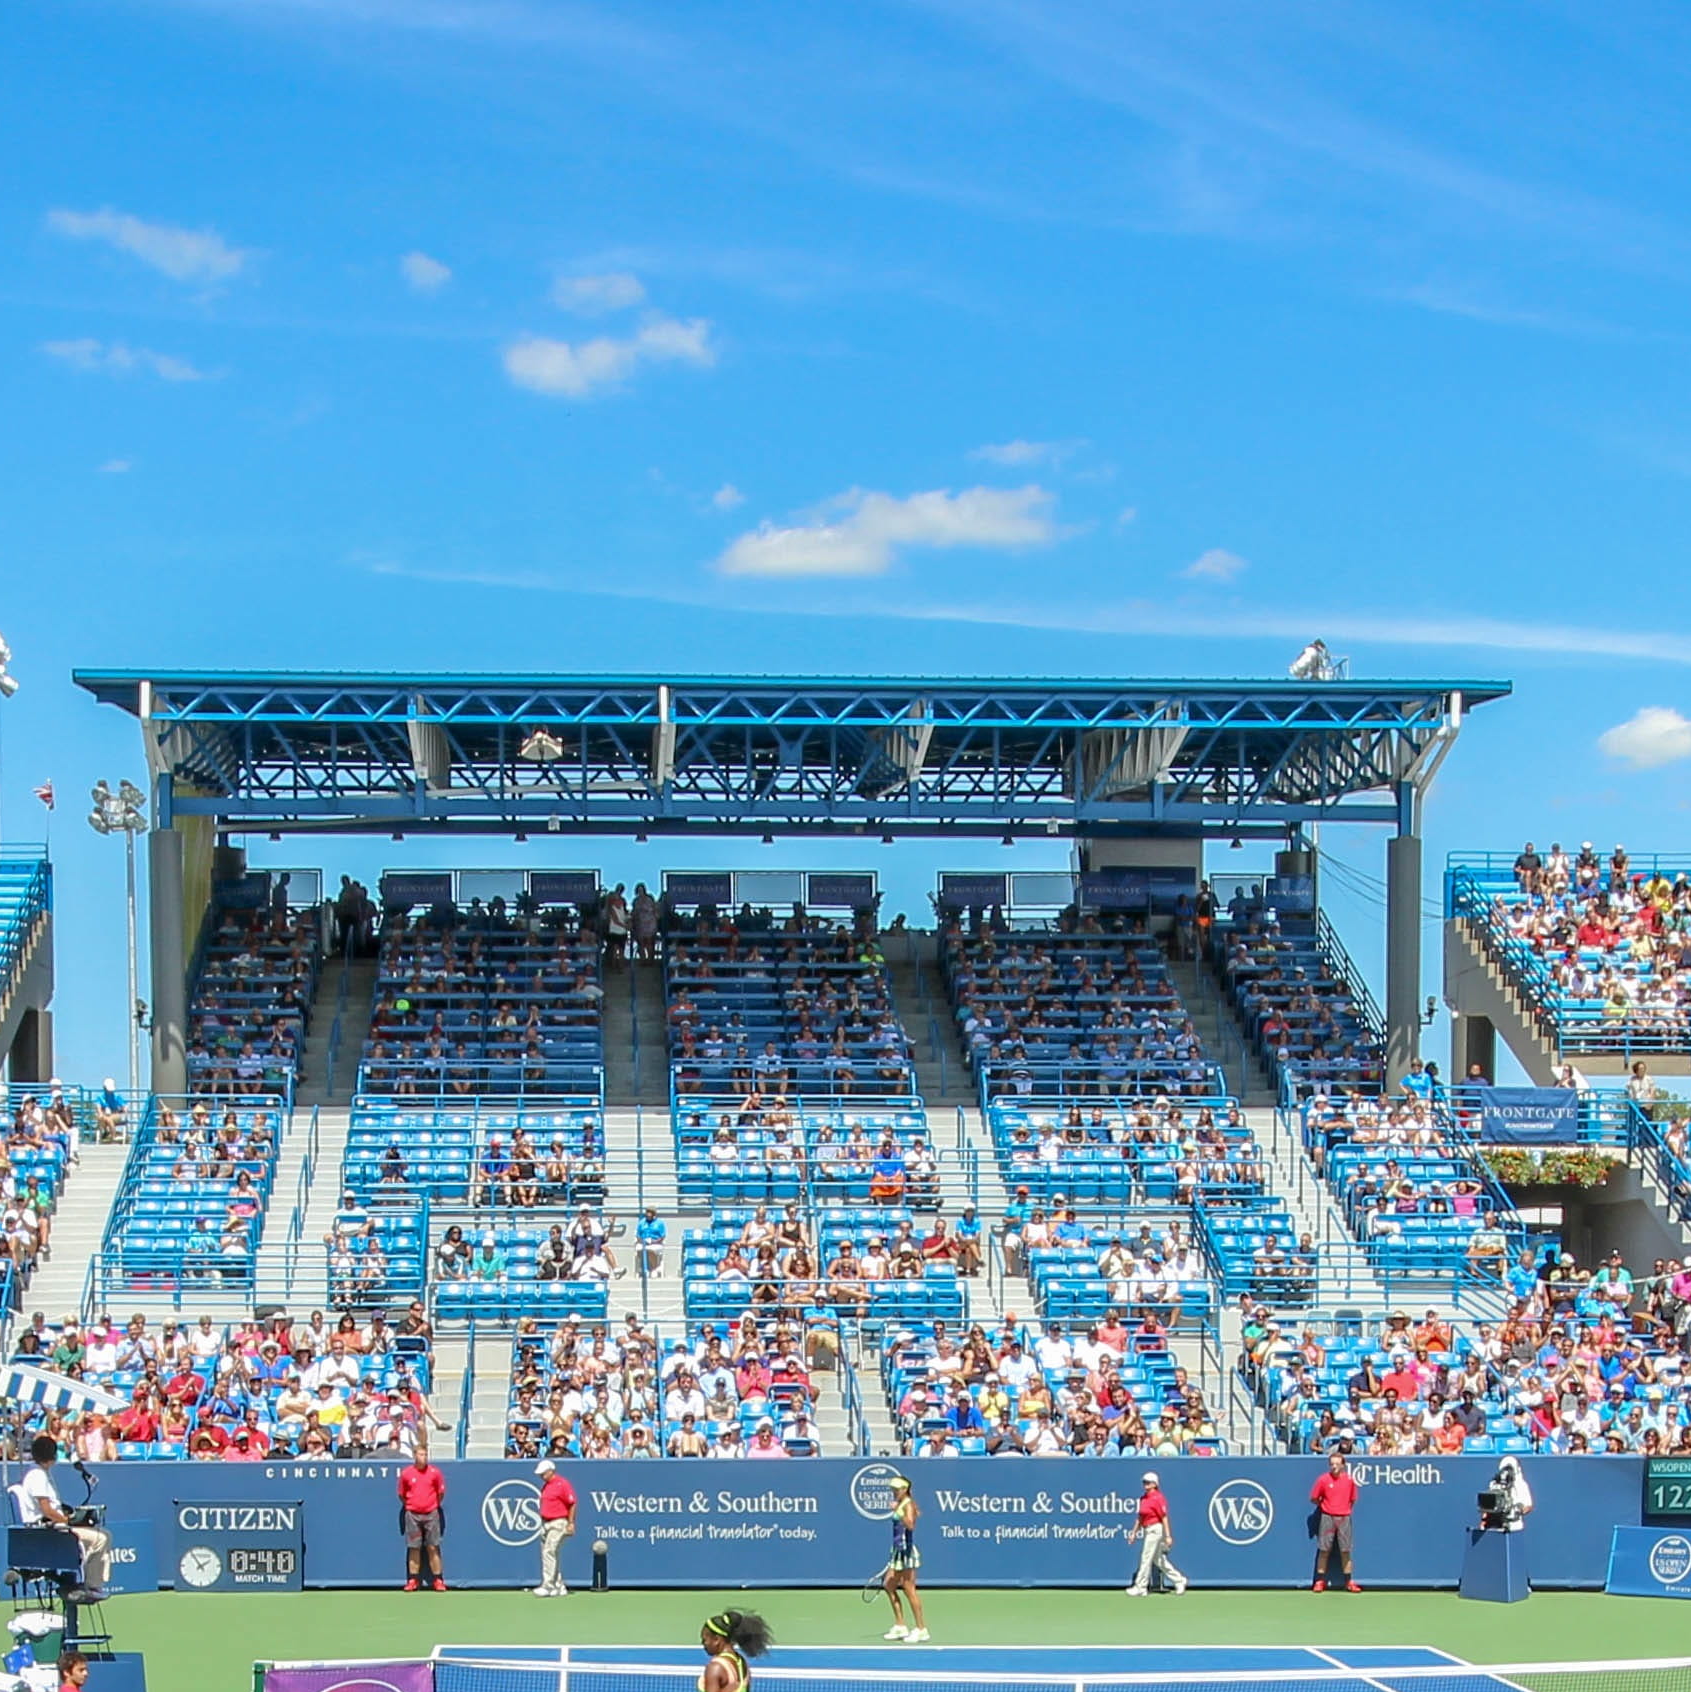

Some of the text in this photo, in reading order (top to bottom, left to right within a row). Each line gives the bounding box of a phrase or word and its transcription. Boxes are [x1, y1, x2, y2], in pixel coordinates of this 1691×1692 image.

[1484, 1106, 1574, 1119] FRONTGATE
[265, 1467, 402, 1479] CINCINNATI
[1375, 1465, 1442, 1485] Health
[590, 1490, 819, 1514] Western & Southern
[935, 1489, 1142, 1513] Western & Souther
[178, 1506, 297, 1531] CITIZEN
[594, 1525, 620, 1539] Talk
[621, 1527, 634, 1539] to
[637, 1529, 646, 1539] a
[649, 1522, 704, 1545] financial
[779, 1525, 818, 1541] today.
[940, 1524, 966, 1539] Talk
[967, 1527, 981, 1539] to
[983, 1529, 991, 1539] a
[994, 1521, 1049, 1545] financial
[234, 1573, 288, 1584] MATCH TIME
